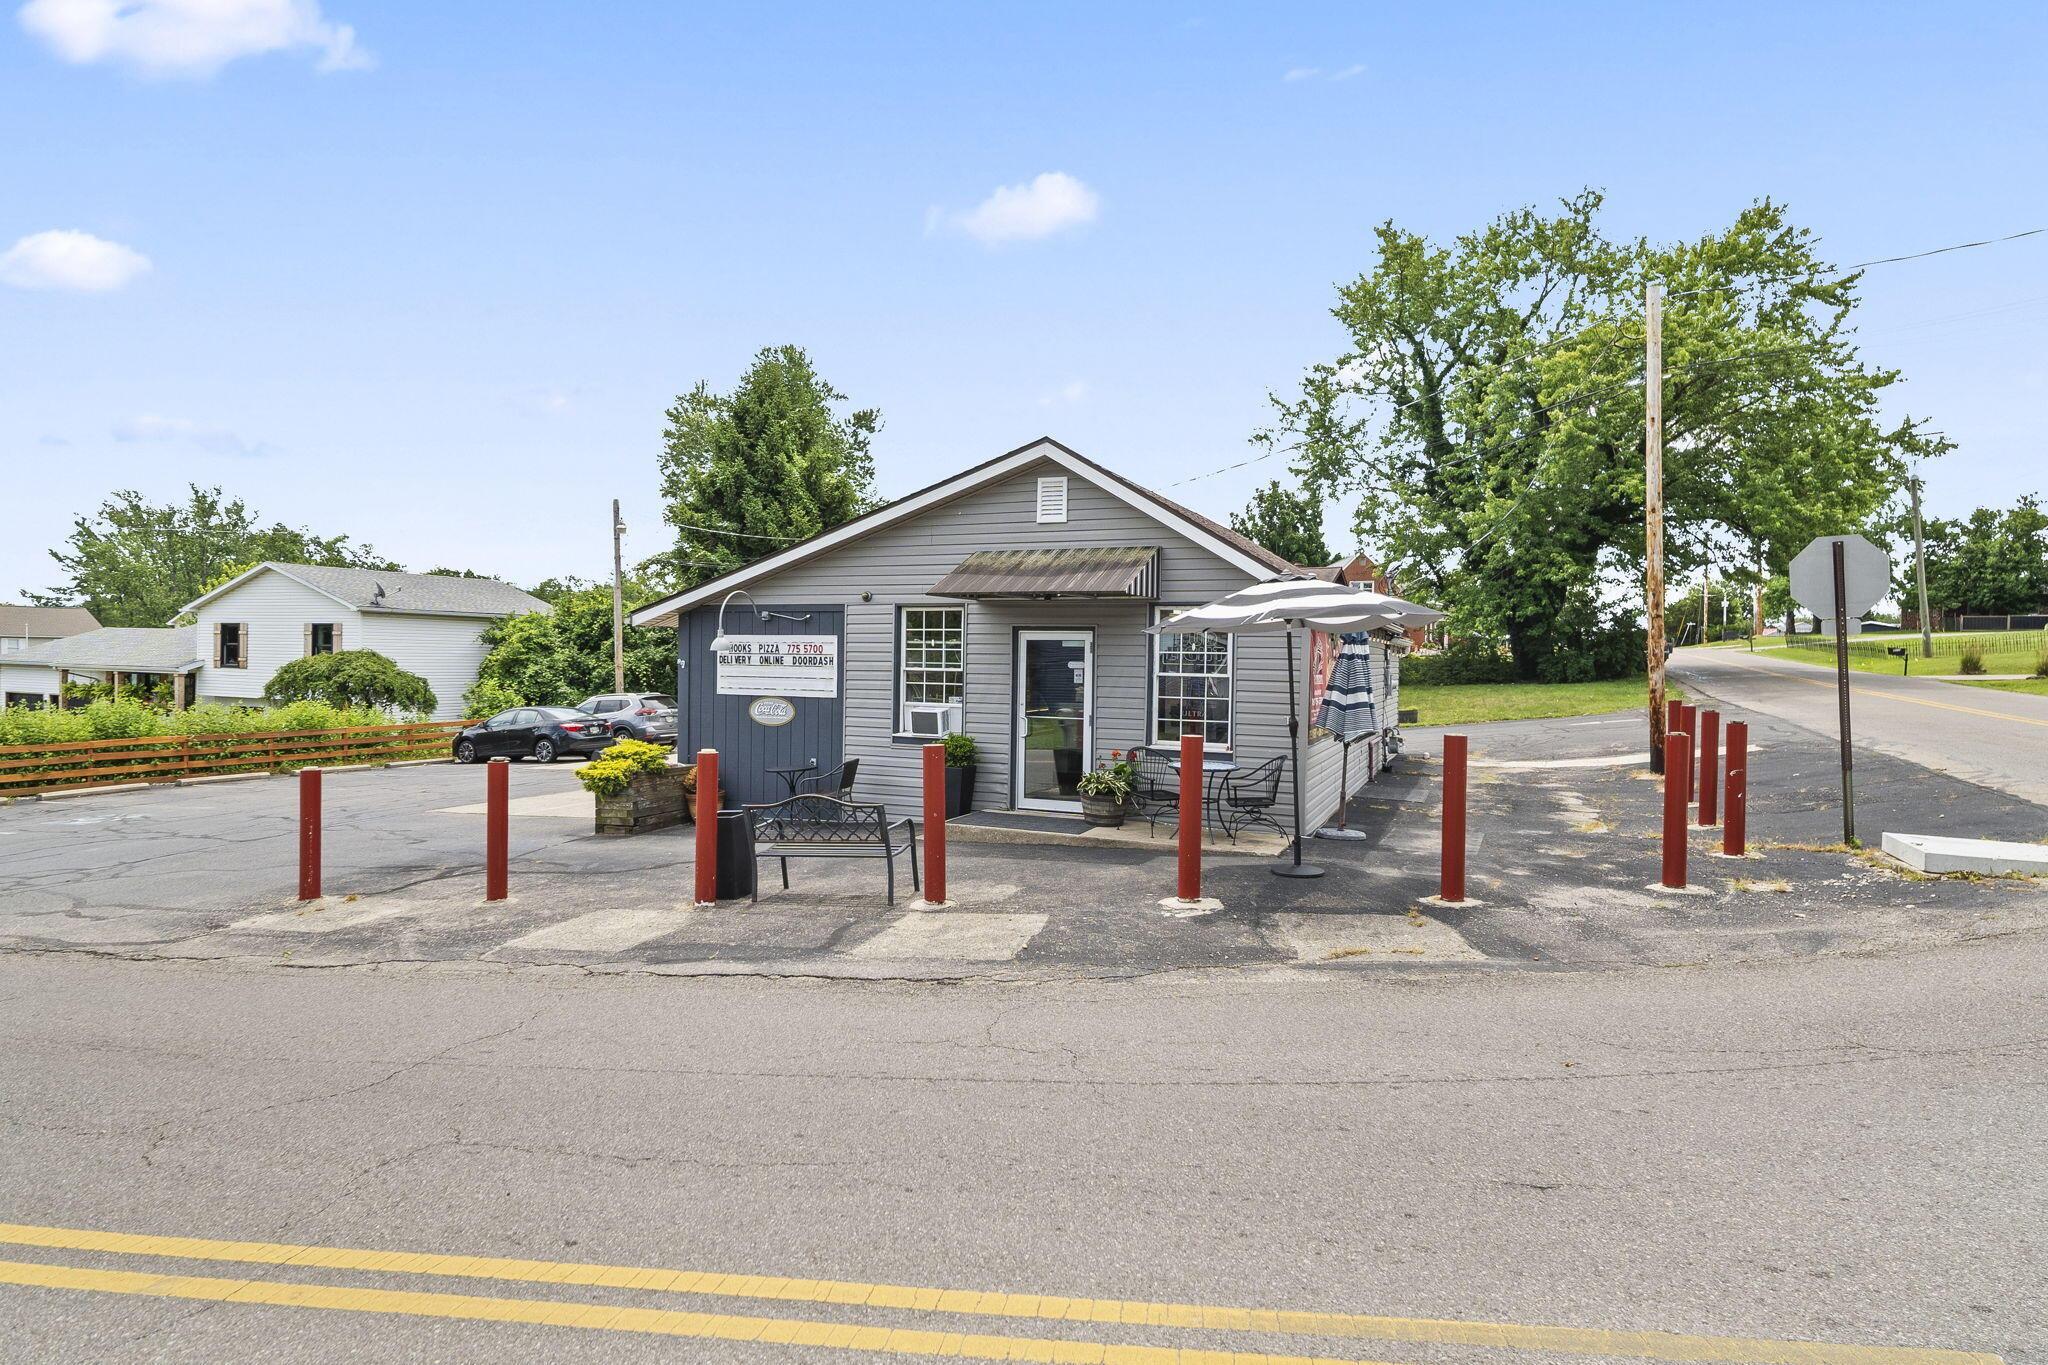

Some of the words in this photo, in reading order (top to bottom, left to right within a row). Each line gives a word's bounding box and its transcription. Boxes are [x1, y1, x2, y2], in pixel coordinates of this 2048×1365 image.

[758, 644, 780, 653] PIZZA
[787, 644, 801, 654] 775
[803, 644, 824, 654] 5700
[719, 655, 752, 664] DELIVERY
[759, 656, 784, 665] ONLINE
[792, 656, 834, 665] DOORDASH
